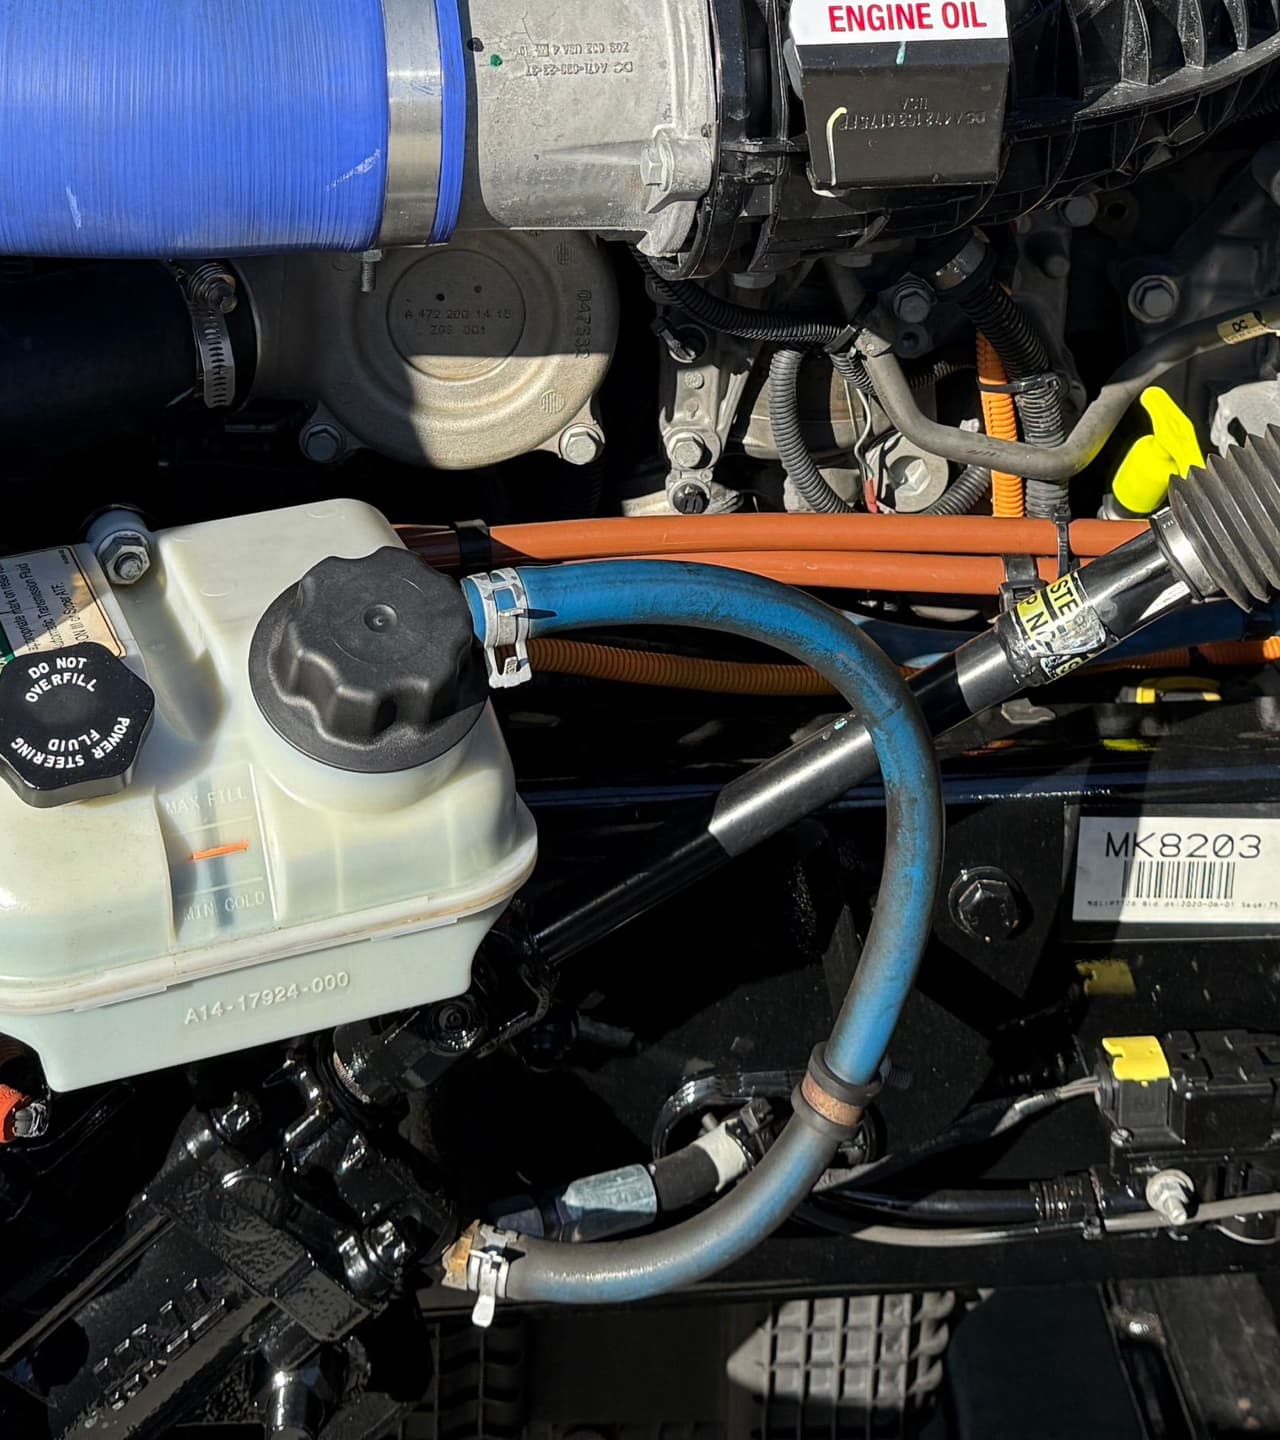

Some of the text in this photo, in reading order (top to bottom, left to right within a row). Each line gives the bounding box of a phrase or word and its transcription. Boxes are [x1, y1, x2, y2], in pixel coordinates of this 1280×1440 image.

[828, 2, 987, 32] ENGINE OIL
[463, 325, 486, 336] 001
[1231, 320, 1248, 332] DC
[16, 562, 31, 581] Fluid
[28, 656, 88, 680] DO NOT
[24, 672, 98, 704] OVERFILL
[10, 716, 130, 770] POWER STEERING
[48, 728, 101, 752] FLUID
[165, 788, 248, 817] MAX FILL
[1105, 831, 1262, 859] MK8203
[184, 971, 350, 1026] A14-17924-000
